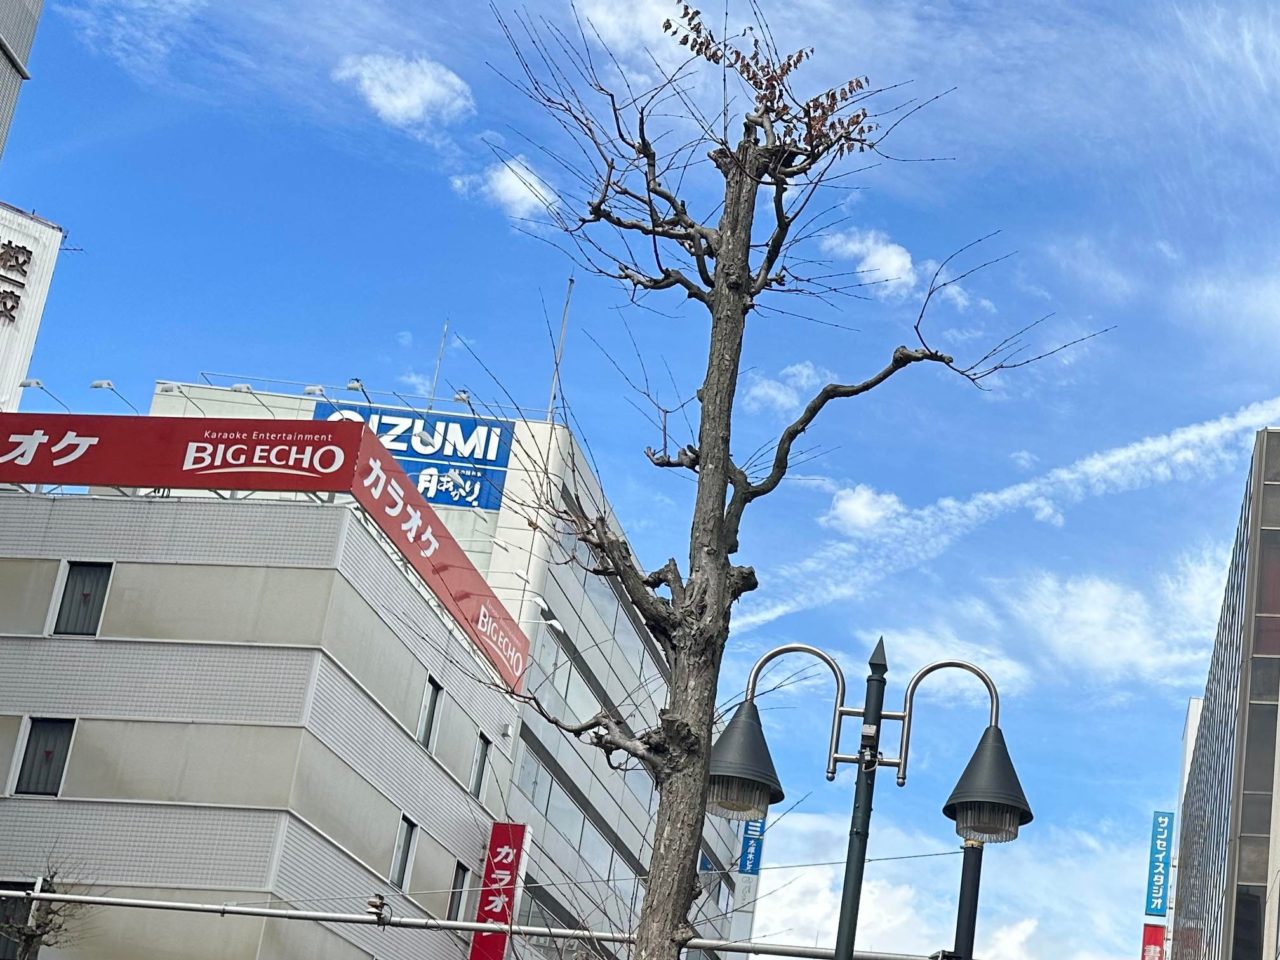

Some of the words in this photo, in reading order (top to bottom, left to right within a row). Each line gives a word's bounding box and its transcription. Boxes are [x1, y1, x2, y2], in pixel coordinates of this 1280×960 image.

[182, 441, 248, 471] BIG
[252, 445, 345, 473] ECHO
[204, 430, 248, 440] Karaoke
[251, 431, 333, 442] Entertainment
[363, 457, 440, 558] カラオケ
[1150, 815, 1169, 910] サンセイスタジオ
